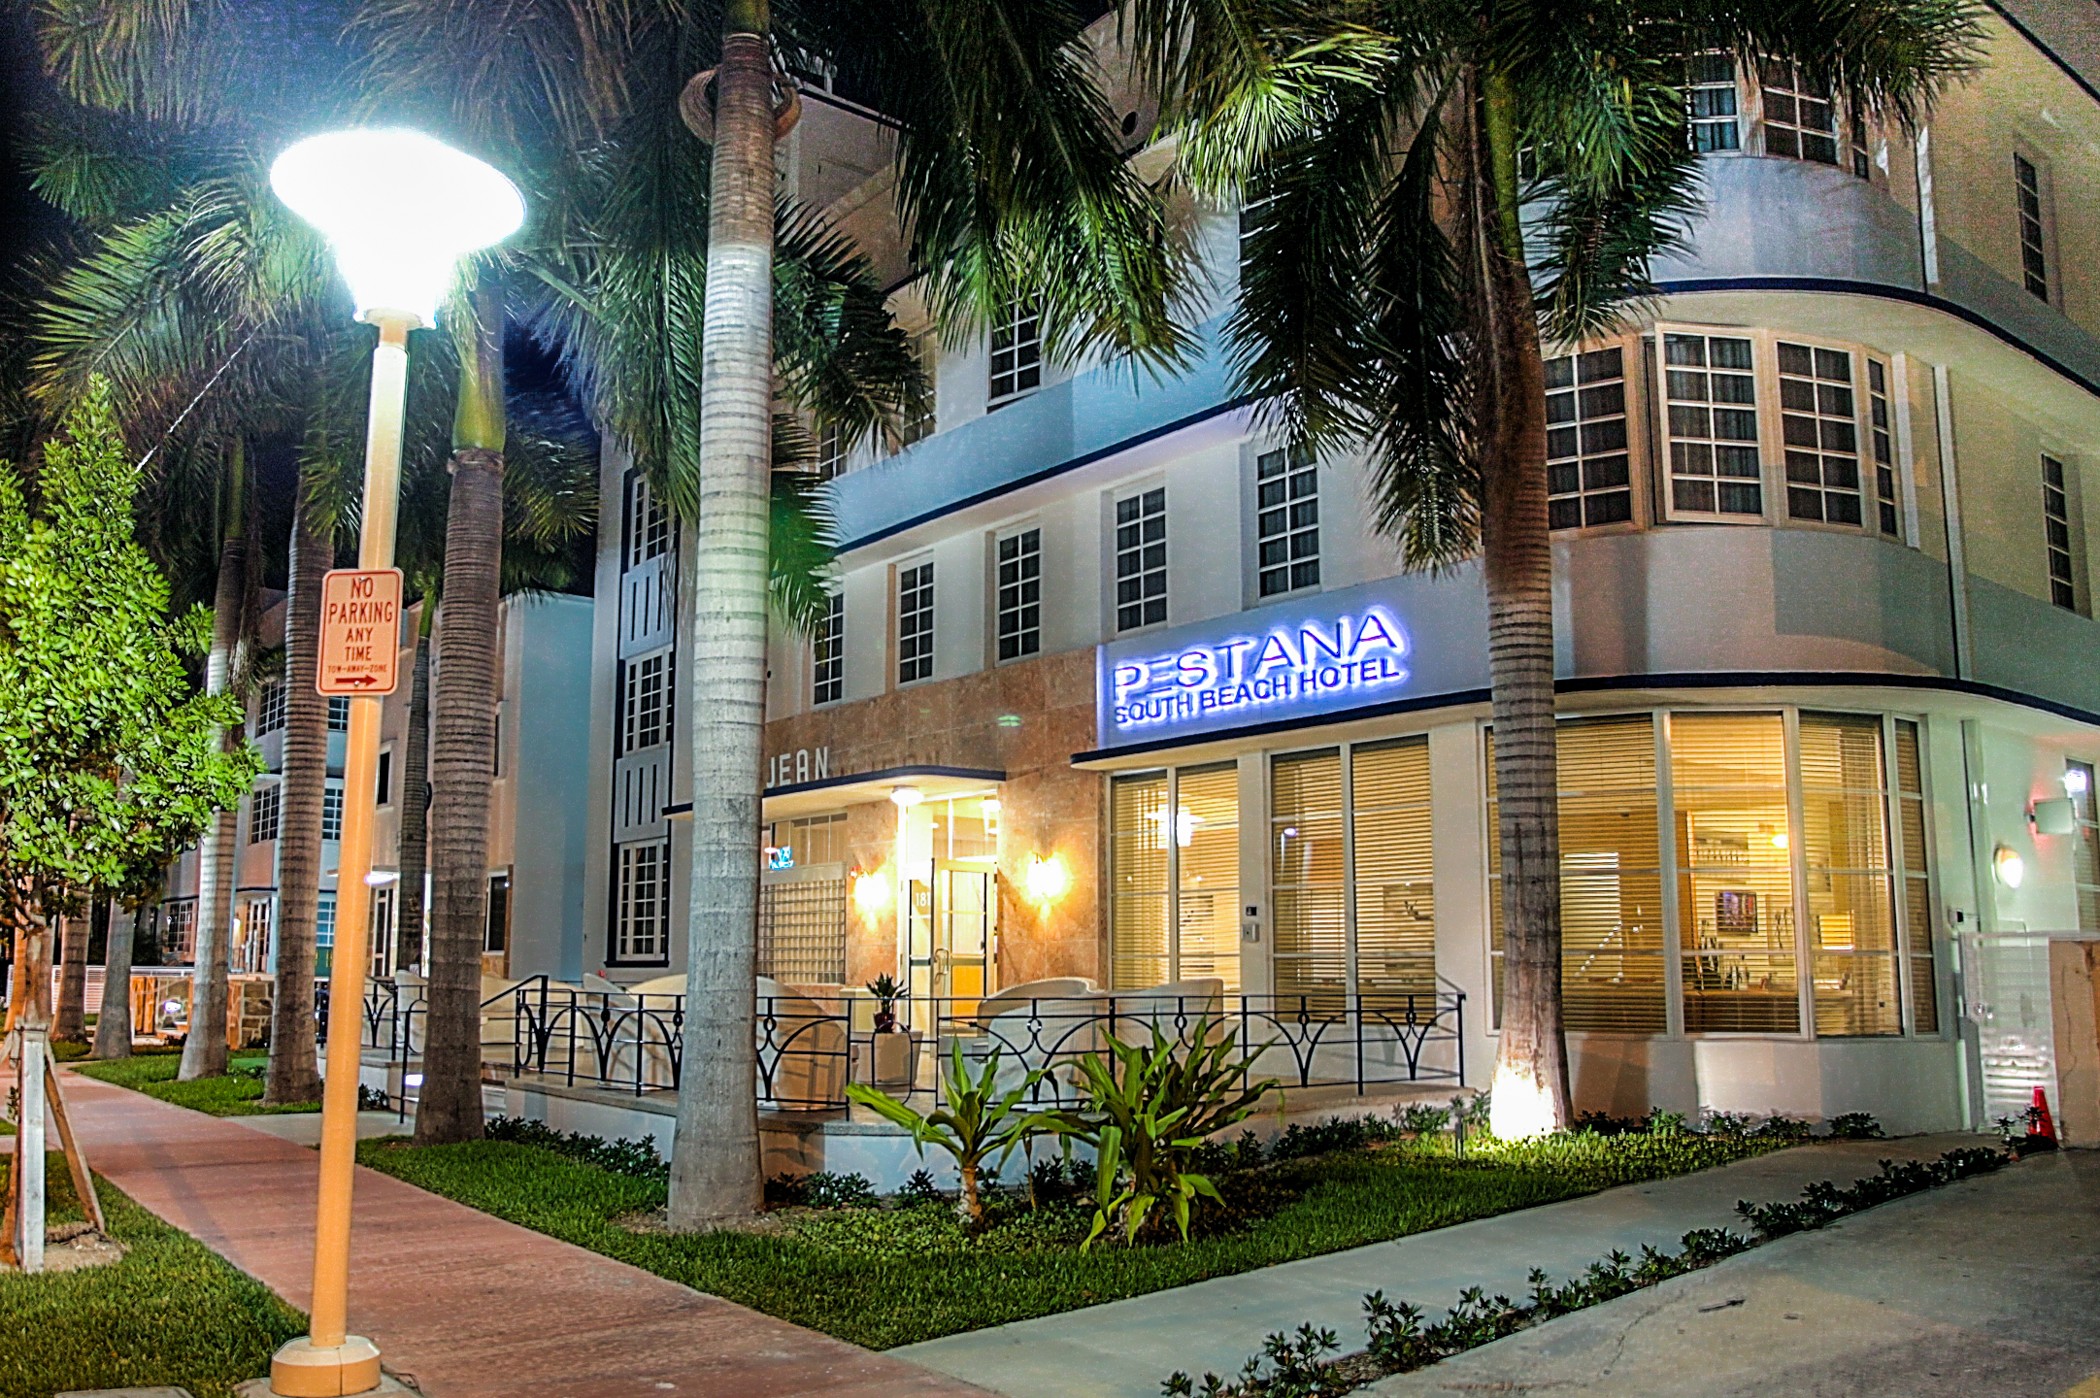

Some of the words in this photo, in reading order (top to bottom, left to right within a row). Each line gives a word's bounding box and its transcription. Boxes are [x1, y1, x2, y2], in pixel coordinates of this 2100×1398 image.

[350, 576, 374, 599] NO
[327, 601, 394, 625] PARKING
[345, 627, 375, 643] ANY
[344, 645, 373, 662] TIME
[1112, 611, 1401, 701] PESTANA
[1113, 692, 1196, 726] SOUTH
[1200, 676, 1292, 711] BEACH
[1299, 656, 1402, 694] HOTEL
[766, 746, 829, 789] JEAN
